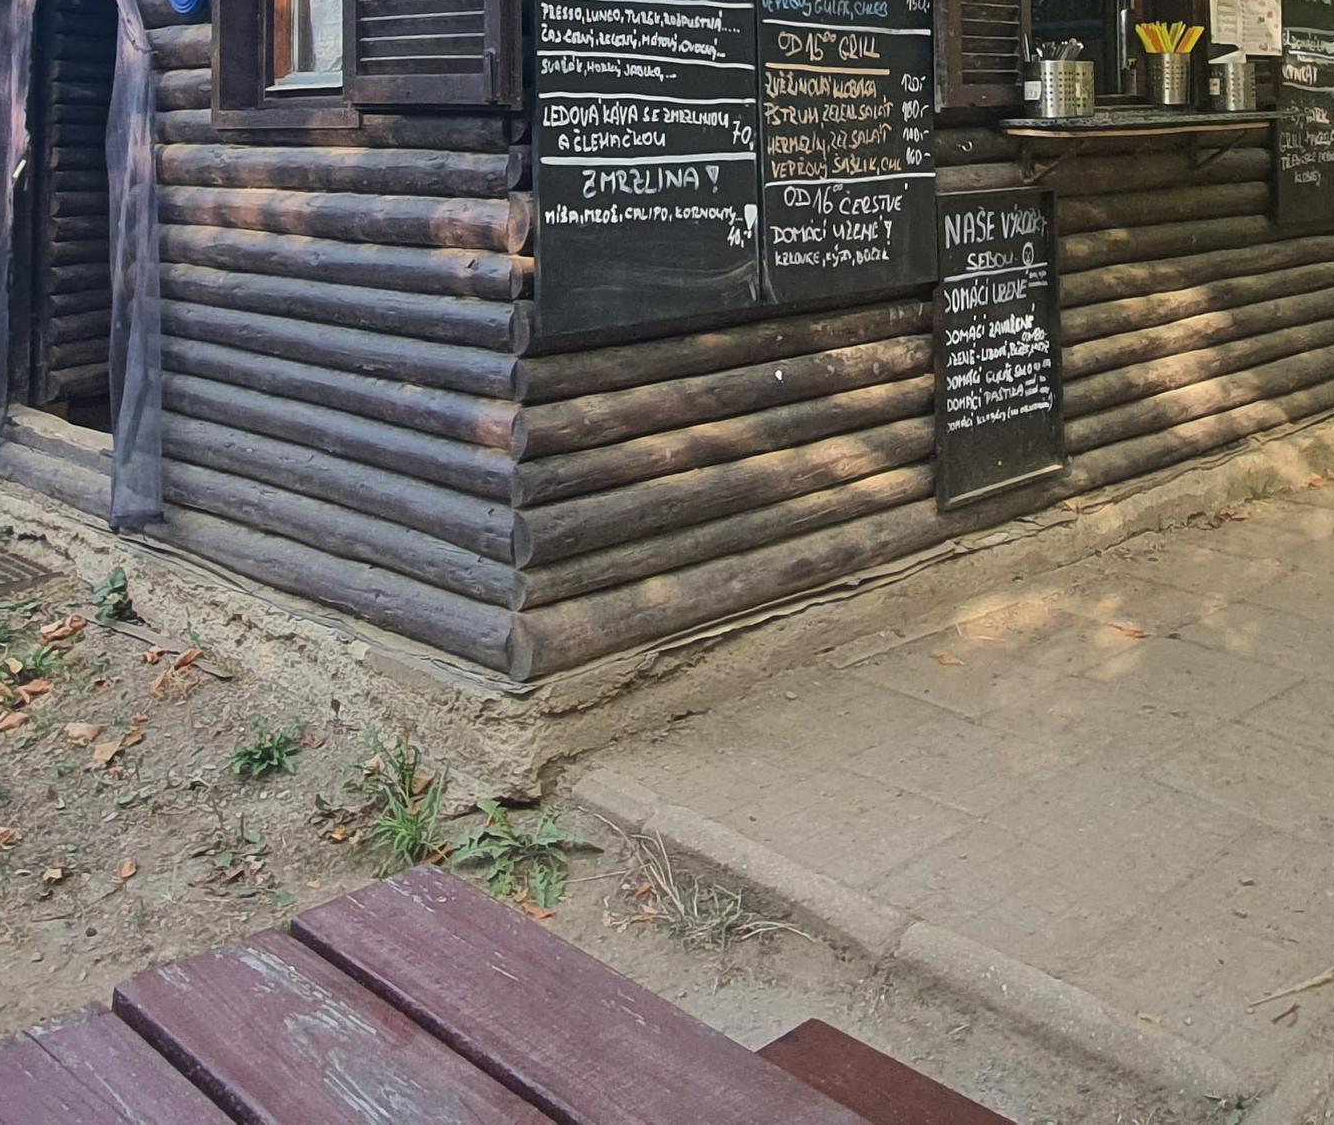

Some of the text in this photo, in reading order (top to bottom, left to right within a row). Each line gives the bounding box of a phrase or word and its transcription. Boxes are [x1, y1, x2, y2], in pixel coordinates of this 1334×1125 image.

[778, 31, 803, 56] OD
[839, 34, 880, 60] GRILL
[543, 98, 602, 127] LEDOVÁ
[603, 101, 638, 125] KÁVA
[642, 106, 659, 123] SE
[573, 128, 666, 152] ŠLEHAČKOU
[582, 167, 700, 198] ZMRZLINA
[783, 185, 811, 207] OD
[945, 206, 995, 249] NAŠE
